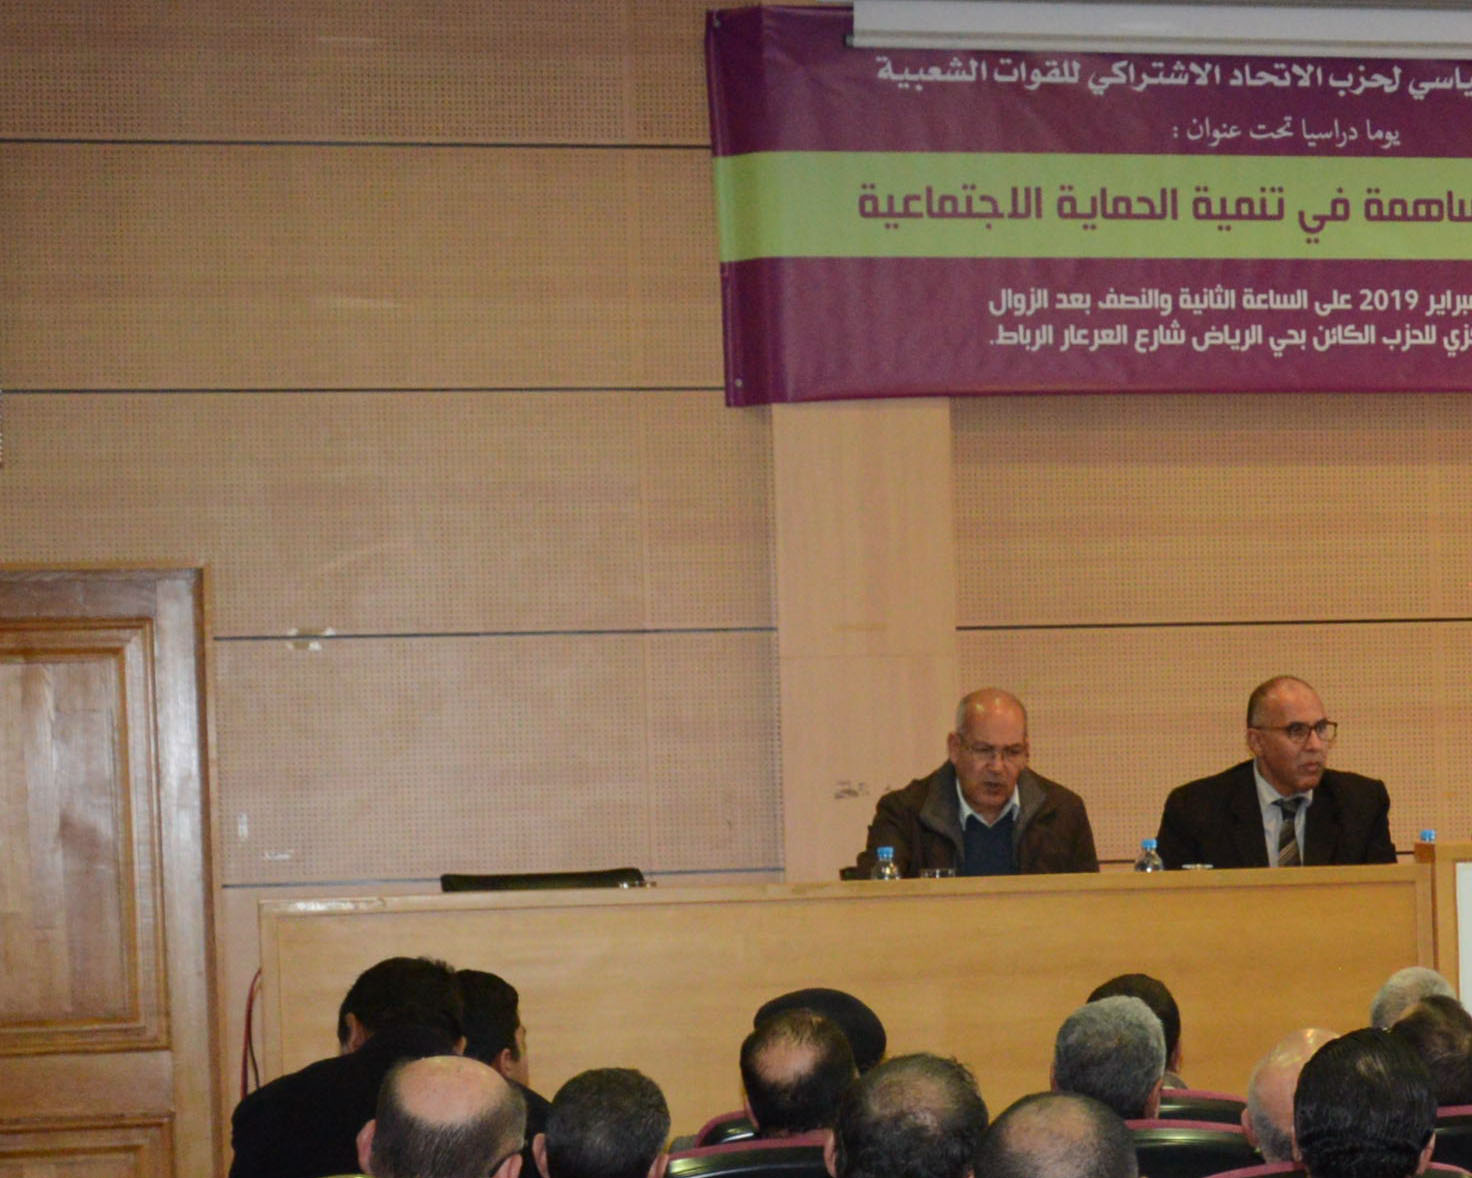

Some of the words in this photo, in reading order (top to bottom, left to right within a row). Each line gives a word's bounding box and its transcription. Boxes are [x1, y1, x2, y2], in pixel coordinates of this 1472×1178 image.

[875, 56, 988, 92] الشعبية
[993, 58, 1081, 91] للقوات
[1087, 60, 1221, 97] الاشتراكي
[1229, 63, 1323, 87] الاتحاد
[1328, 65, 1402, 97] لحزب
[1249, 115, 1294, 140] تحت
[1301, 118, 1359, 148] دراسيا
[1366, 119, 1401, 150] يوما
[858, 183, 1043, 230] الاجتماعية
[1056, 184, 1179, 231] الحماية
[1191, 185, 1285, 232] تنمية
[1297, 187, 1351, 245] في
[988, 287, 1049, 317] الزوال
[1055, 293, 1092, 315] بعد
[1097, 287, 1173, 317] والنصف
[1178, 283, 1236, 315] الثانية
[1242, 287, 1309, 310] الساعة
[1314, 289, 1353, 317] على
[1359, 288, 1419, 311] 2019
[1059, 324, 1128, 352] العرعار
[1134, 319, 1186, 354] شارع
[1191, 324, 1263, 352] الرياض
[1268, 329, 1307, 358] بحي
[1312, 324, 1376, 352] الكائن
[1381, 323, 1437, 352] للحزب
